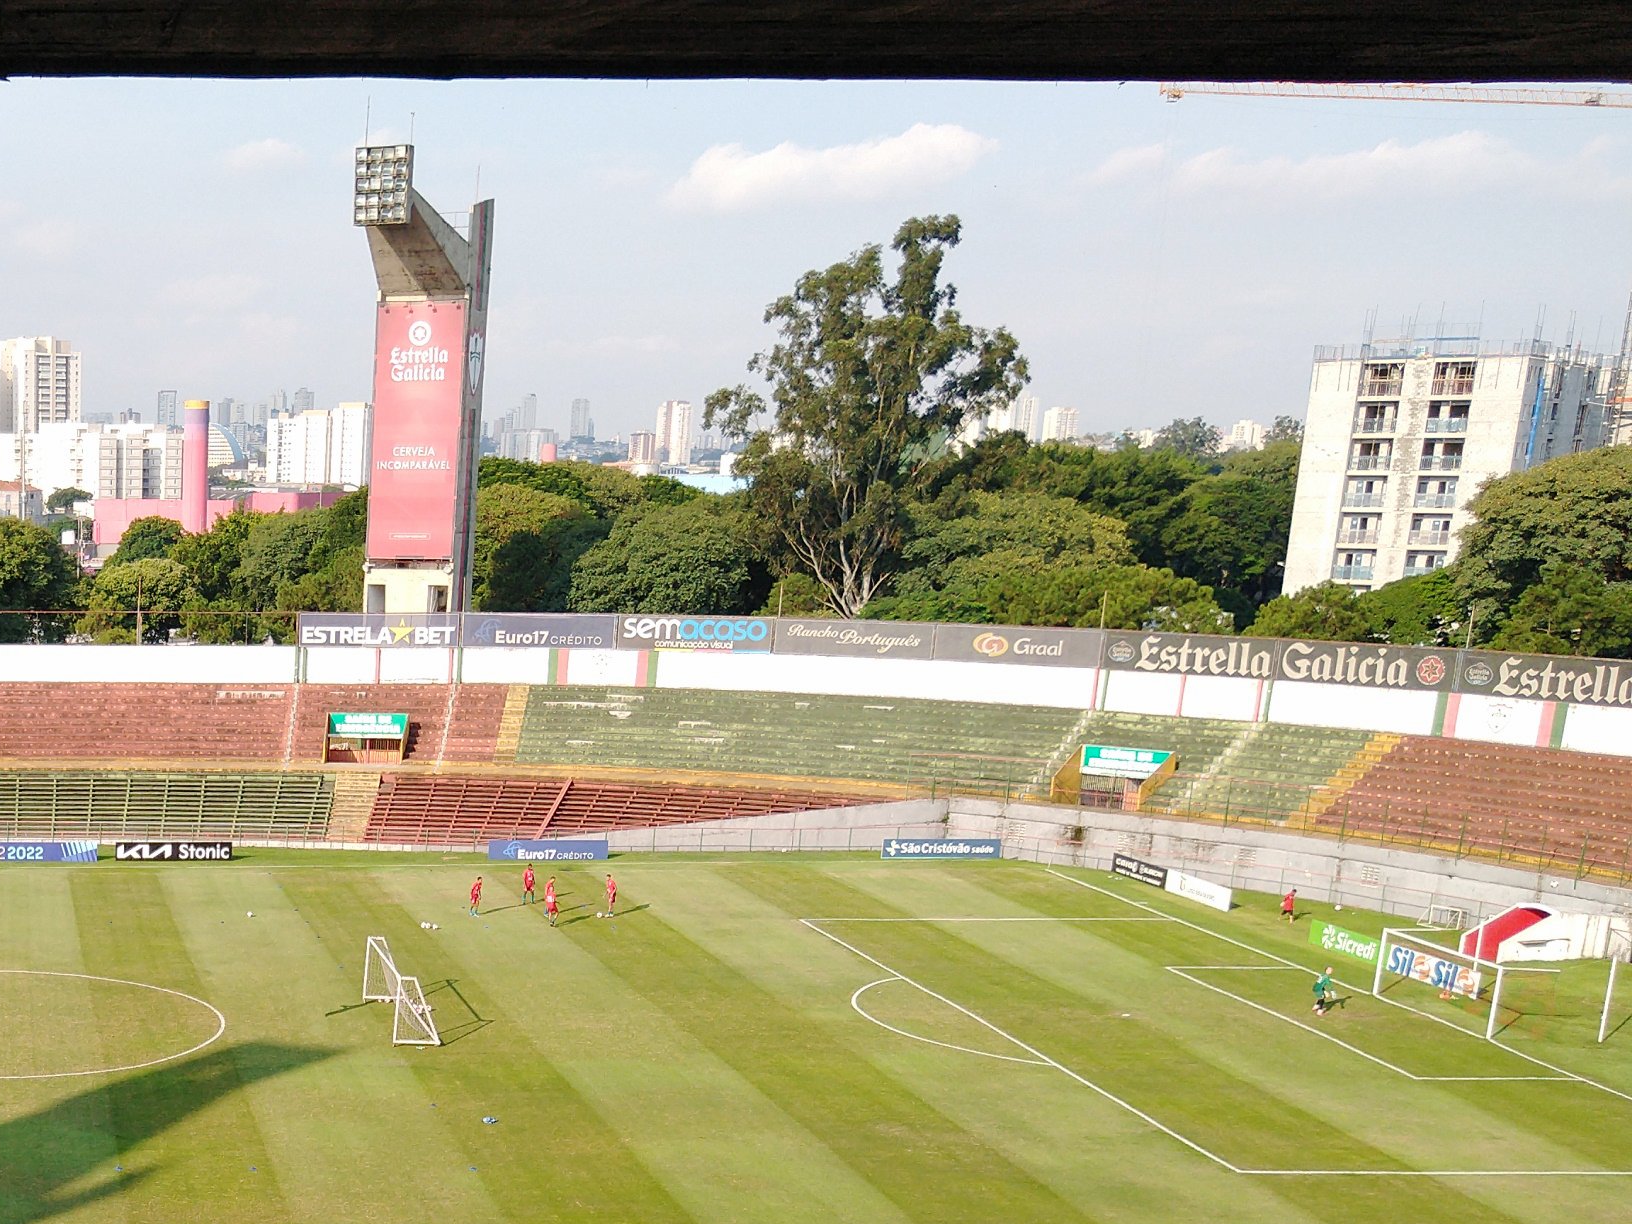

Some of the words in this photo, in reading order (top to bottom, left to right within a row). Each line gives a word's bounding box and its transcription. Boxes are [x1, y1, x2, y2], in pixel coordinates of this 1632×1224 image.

[389, 346, 448, 364] Estrella
[391, 364, 445, 382] Galicia
[392, 446, 436, 457] CERVEJA
[376, 459, 450, 470] INCOMPARÁVEL
[302, 626, 392, 644] ESTRELA
[411, 626, 456, 644] BET
[495, 630, 549, 645] Euro17
[550, 634, 602, 646] CRÉDITO
[786, 623, 838, 638] Rancho
[836, 629, 921, 653] Português
[654, 640, 709, 649] comunicação
[710, 640, 734, 650] visual
[1013, 638, 1064, 657] Graal
[1134, 635, 1271, 677] Estrella
[1281, 642, 1408, 687] Galicia
[1492, 656, 1632, 705] Estrella
[7, 846, 43, 860] 2022
[178, 843, 230, 859] Stonic
[517, 848, 556, 860] Euro17
[557, 850, 594, 860] CRÉDITO
[900, 842, 920, 854] São
[921, 842, 970, 854] Cristóvão
[971, 845, 994, 854] saúde
[1334, 933, 1377, 961] Sicredi
[1388, 947, 1415, 976] Sil
[1431, 960, 1459, 992] Sil
